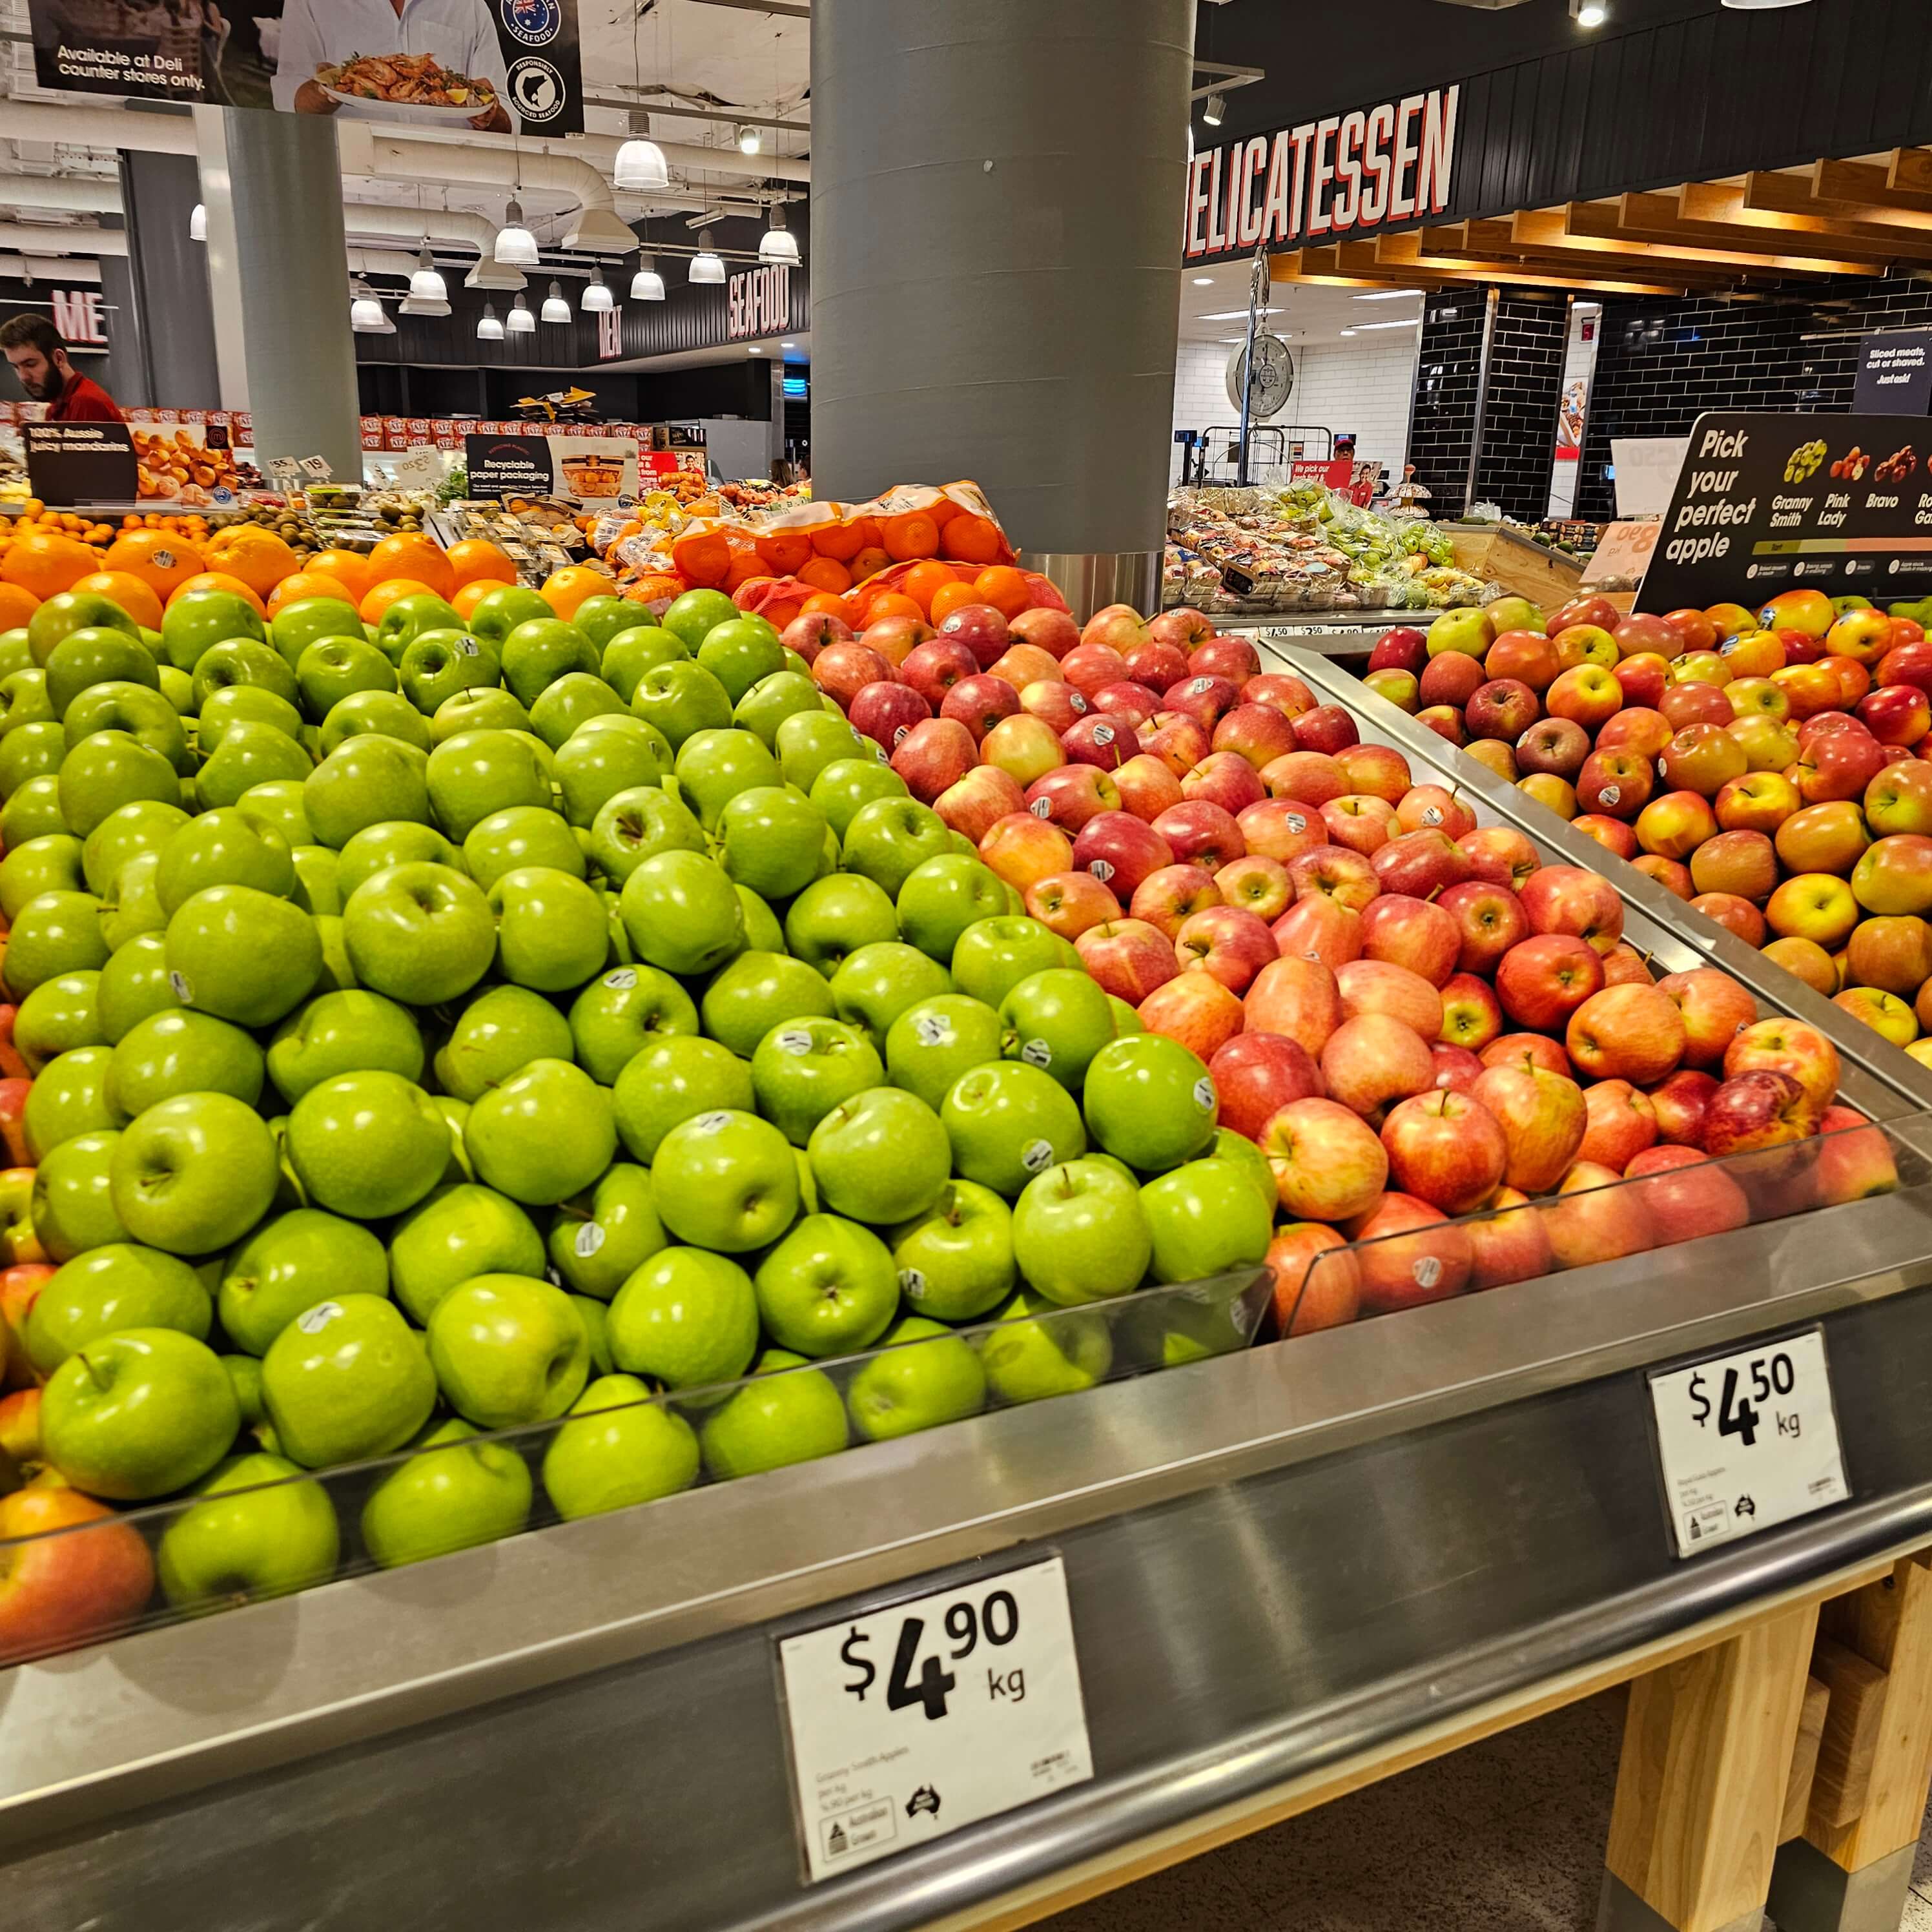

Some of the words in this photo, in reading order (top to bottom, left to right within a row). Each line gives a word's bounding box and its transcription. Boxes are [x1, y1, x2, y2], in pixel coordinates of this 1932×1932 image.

[512, 26, 552, 42] SEAFOOD
[57, 45, 130, 65] Available
[134, 54, 151, 68] at
[154, 56, 183, 72] Deli
[59, 63, 119, 79] counter
[123, 68, 167, 85] stores
[170, 75, 205, 91] only.
[1183, 85, 1459, 258] ELICATESSEN
[729, 264, 789, 338] SEAFOOD
[599, 305, 622, 359] MEAT
[1870, 349, 1896, 358] Sliced
[1866, 359, 1880, 369] cut
[1882, 360, 1891, 368] or
[1876, 374, 1895, 384] Just
[1699, 429, 1749, 458] Pick
[484, 460, 535, 470] Recyclable
[1304, 464, 1317, 473] pick
[470, 471, 498, 480] paper
[500, 471, 550, 482] packaging
[1687, 470, 1739, 498] your
[1772, 495, 1813, 512] Granny
[1824, 493, 1851, 508] Pink
[1865, 493, 1899, 508] Bravo
[1918, 493, 1932, 508] Ro
[1674, 497, 1756, 532] perfect
[1769, 512, 1802, 528] Smith
[1817, 511, 1847, 528] Lady
[1666, 532, 1730, 564] apple
[1776, 1411, 1801, 1438] kg
[987, 1667, 1026, 1703] kg
